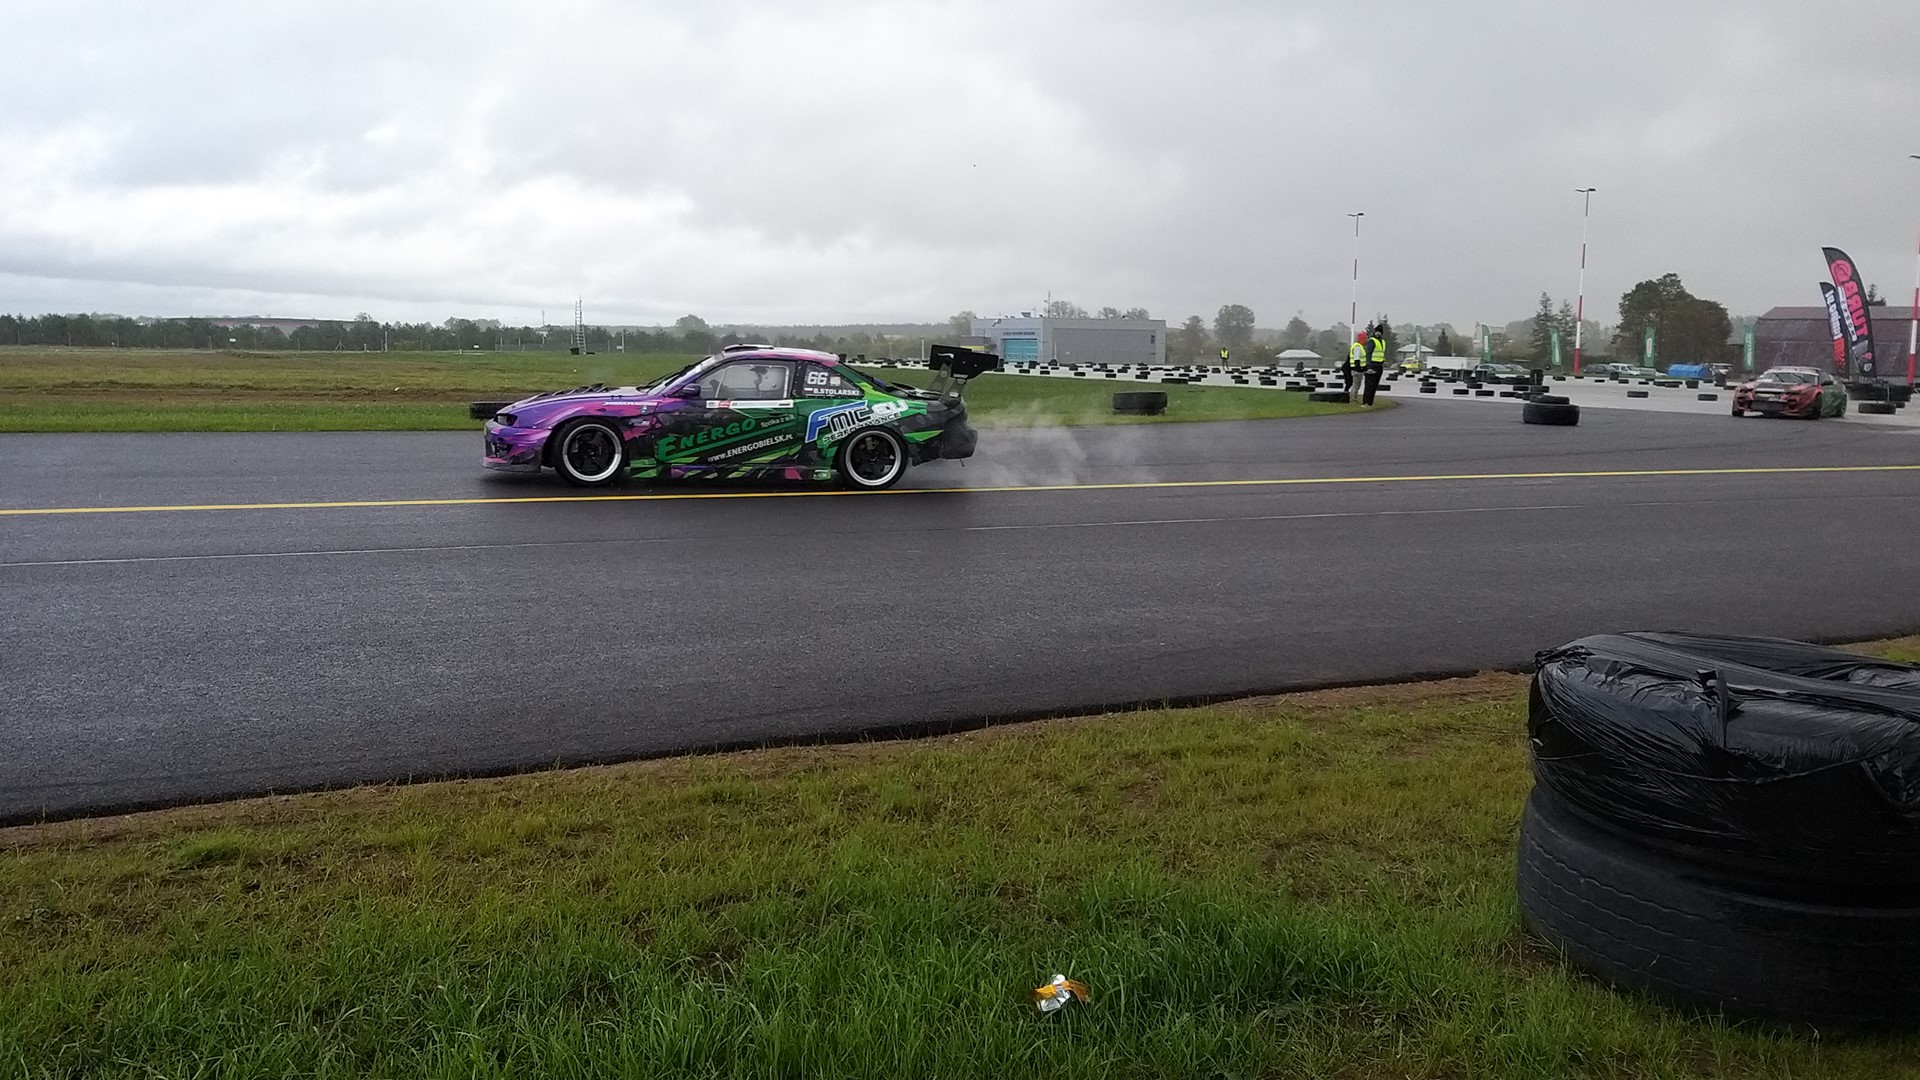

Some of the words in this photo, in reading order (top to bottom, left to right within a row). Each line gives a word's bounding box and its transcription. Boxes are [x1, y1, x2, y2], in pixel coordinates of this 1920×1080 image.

[807, 371, 828, 385] 66
[813, 387, 860, 396] B.STOLARSKI
[657, 418, 756, 462] ENERGO
